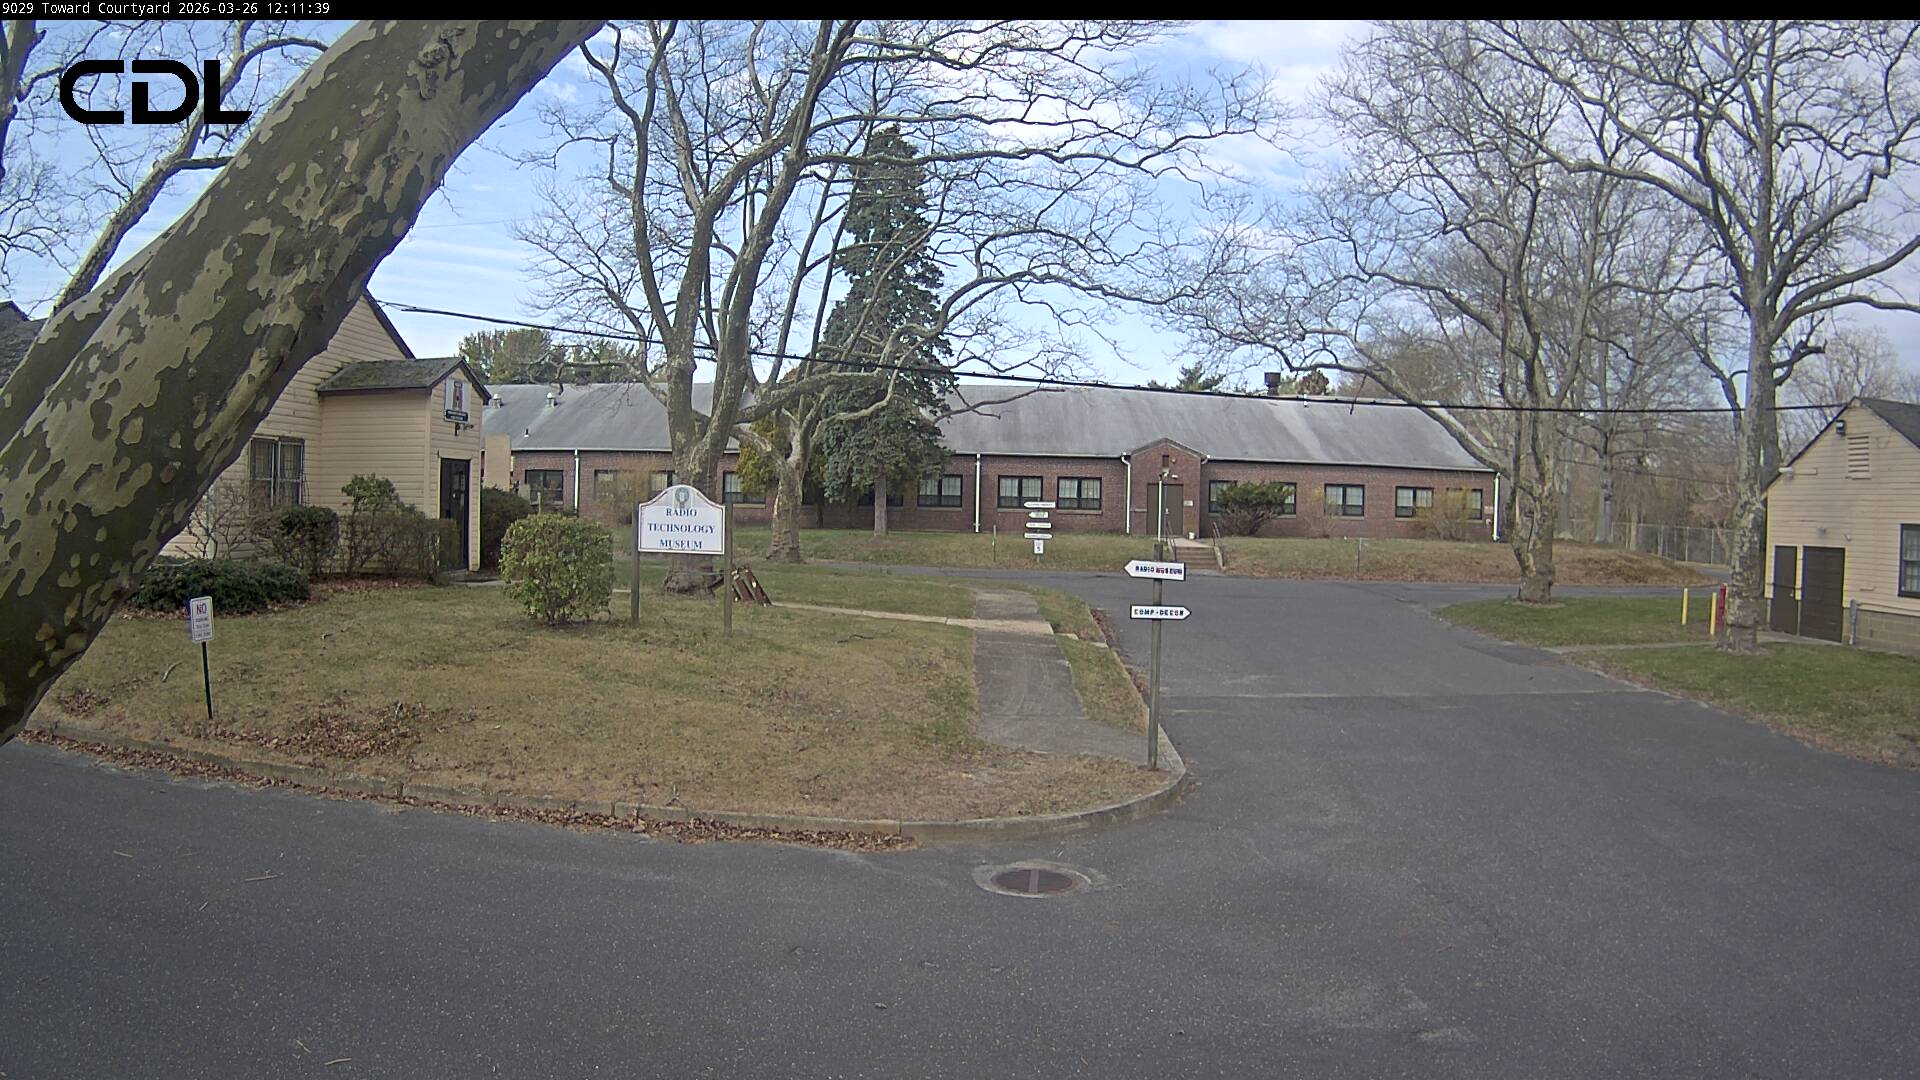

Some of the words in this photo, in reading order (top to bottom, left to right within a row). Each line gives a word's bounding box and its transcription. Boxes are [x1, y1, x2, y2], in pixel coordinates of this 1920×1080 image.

[666, 508, 697, 517] RADIO
[648, 522, 714, 534] TECHNOLOGY
[660, 539, 702, 549] MUSEUM
[196, 603, 207, 615] NO
